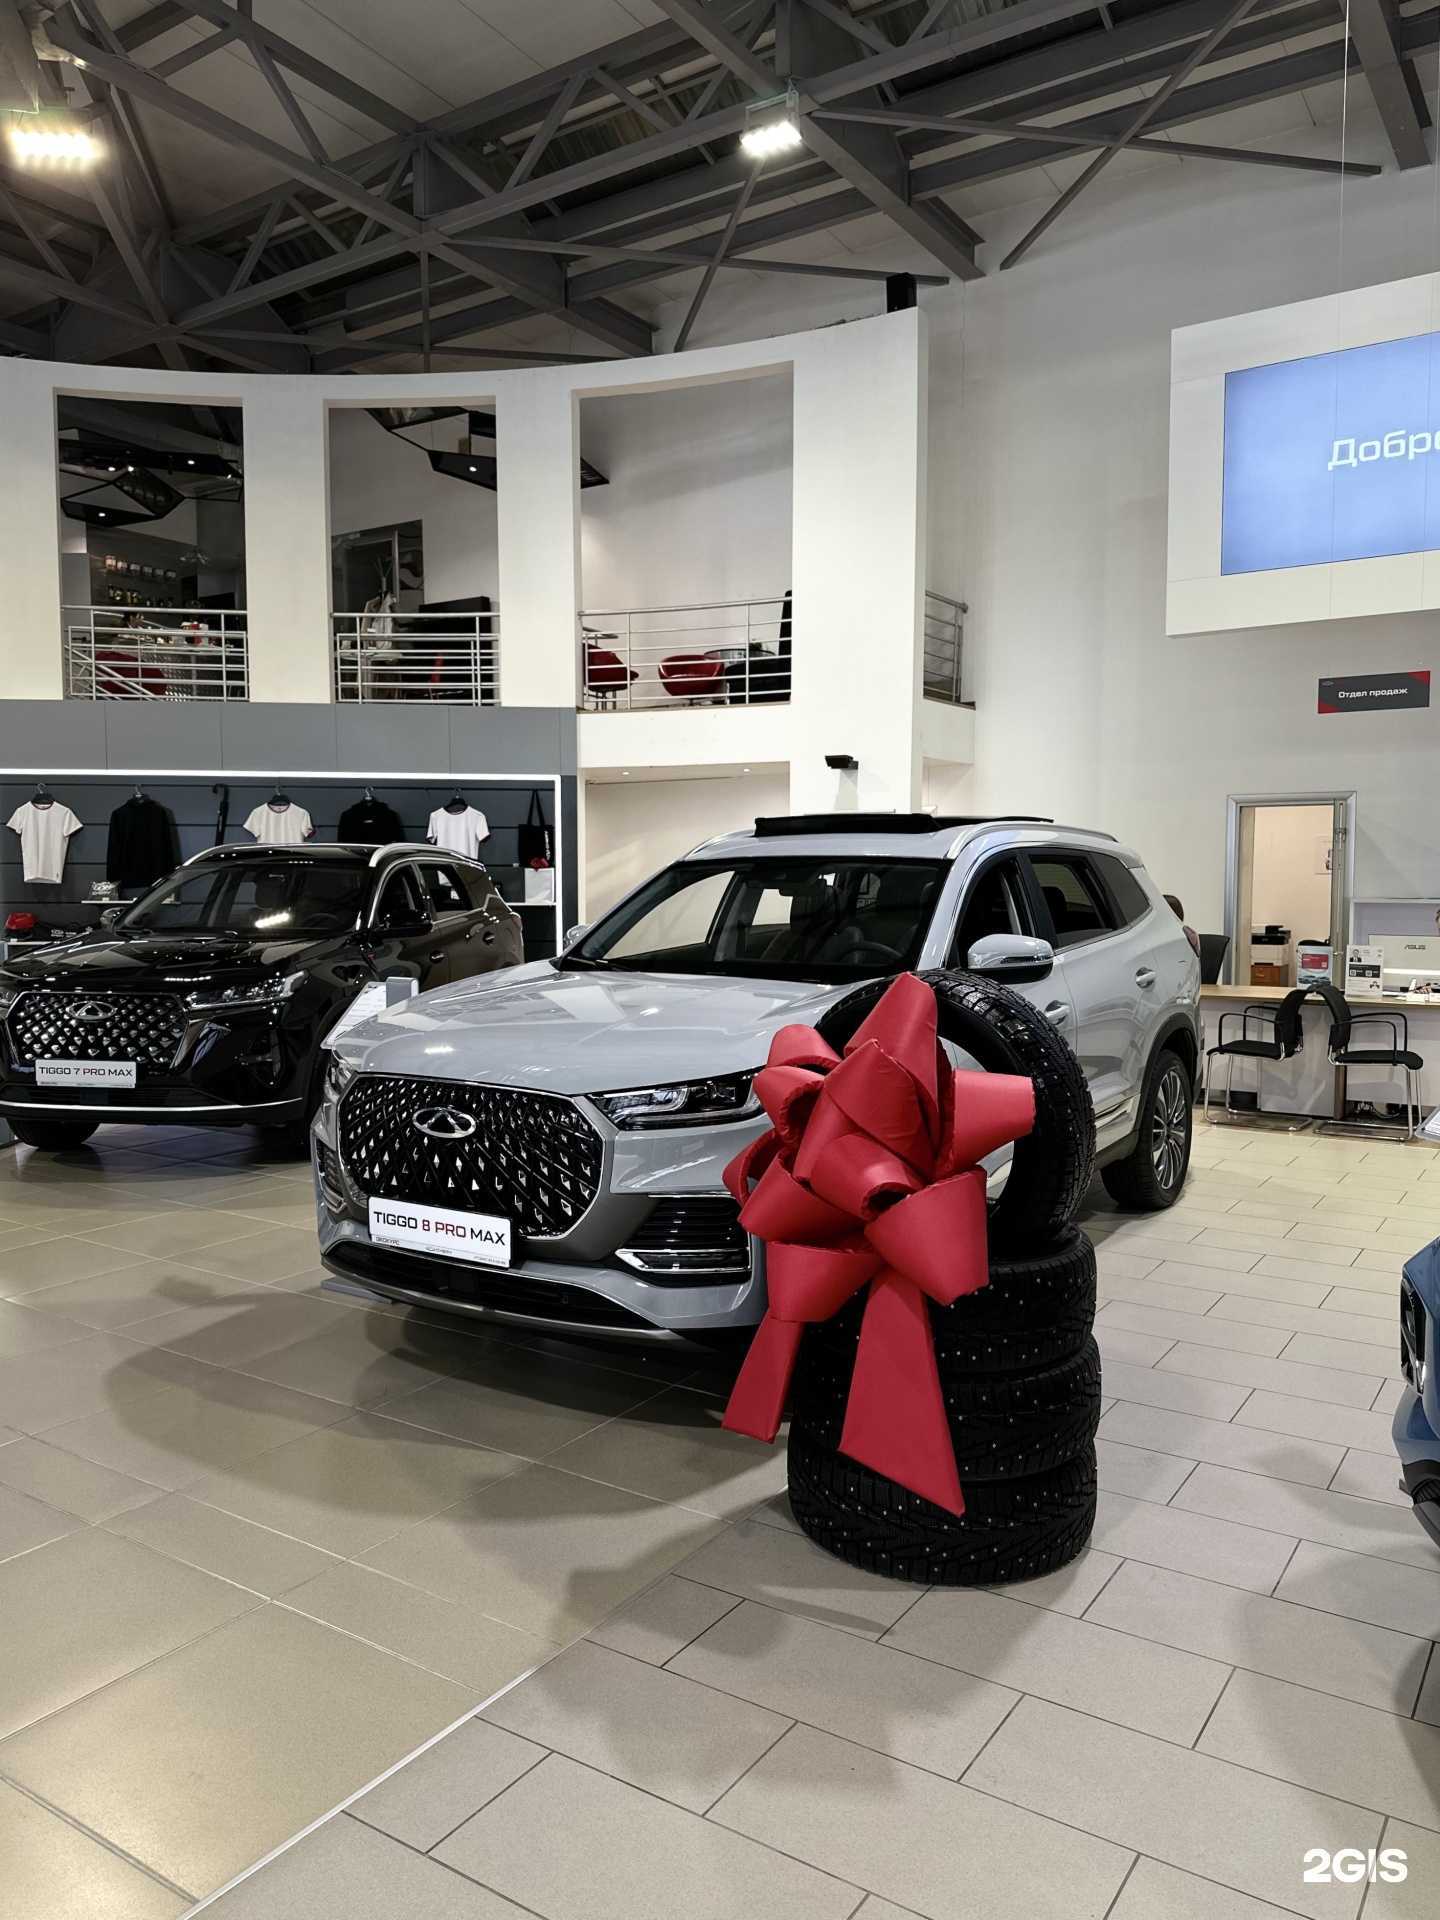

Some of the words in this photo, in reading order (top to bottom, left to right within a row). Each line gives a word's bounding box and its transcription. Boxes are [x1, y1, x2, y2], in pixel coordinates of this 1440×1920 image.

[1327, 431, 1440, 471] Добр
[1338, 689, 1368, 699] Отдел
[1369, 687, 1408, 698] продаж
[38, 1066, 71, 1075] TIGGO
[73, 1067, 81, 1075] 7
[83, 1068, 106, 1076] PRO
[108, 1069, 133, 1077] MAX
[373, 1211, 418, 1229] TIGGO
[421, 1219, 431, 1232] 8
[434, 1221, 467, 1239] PRO
[470, 1227, 506, 1246] MAX
